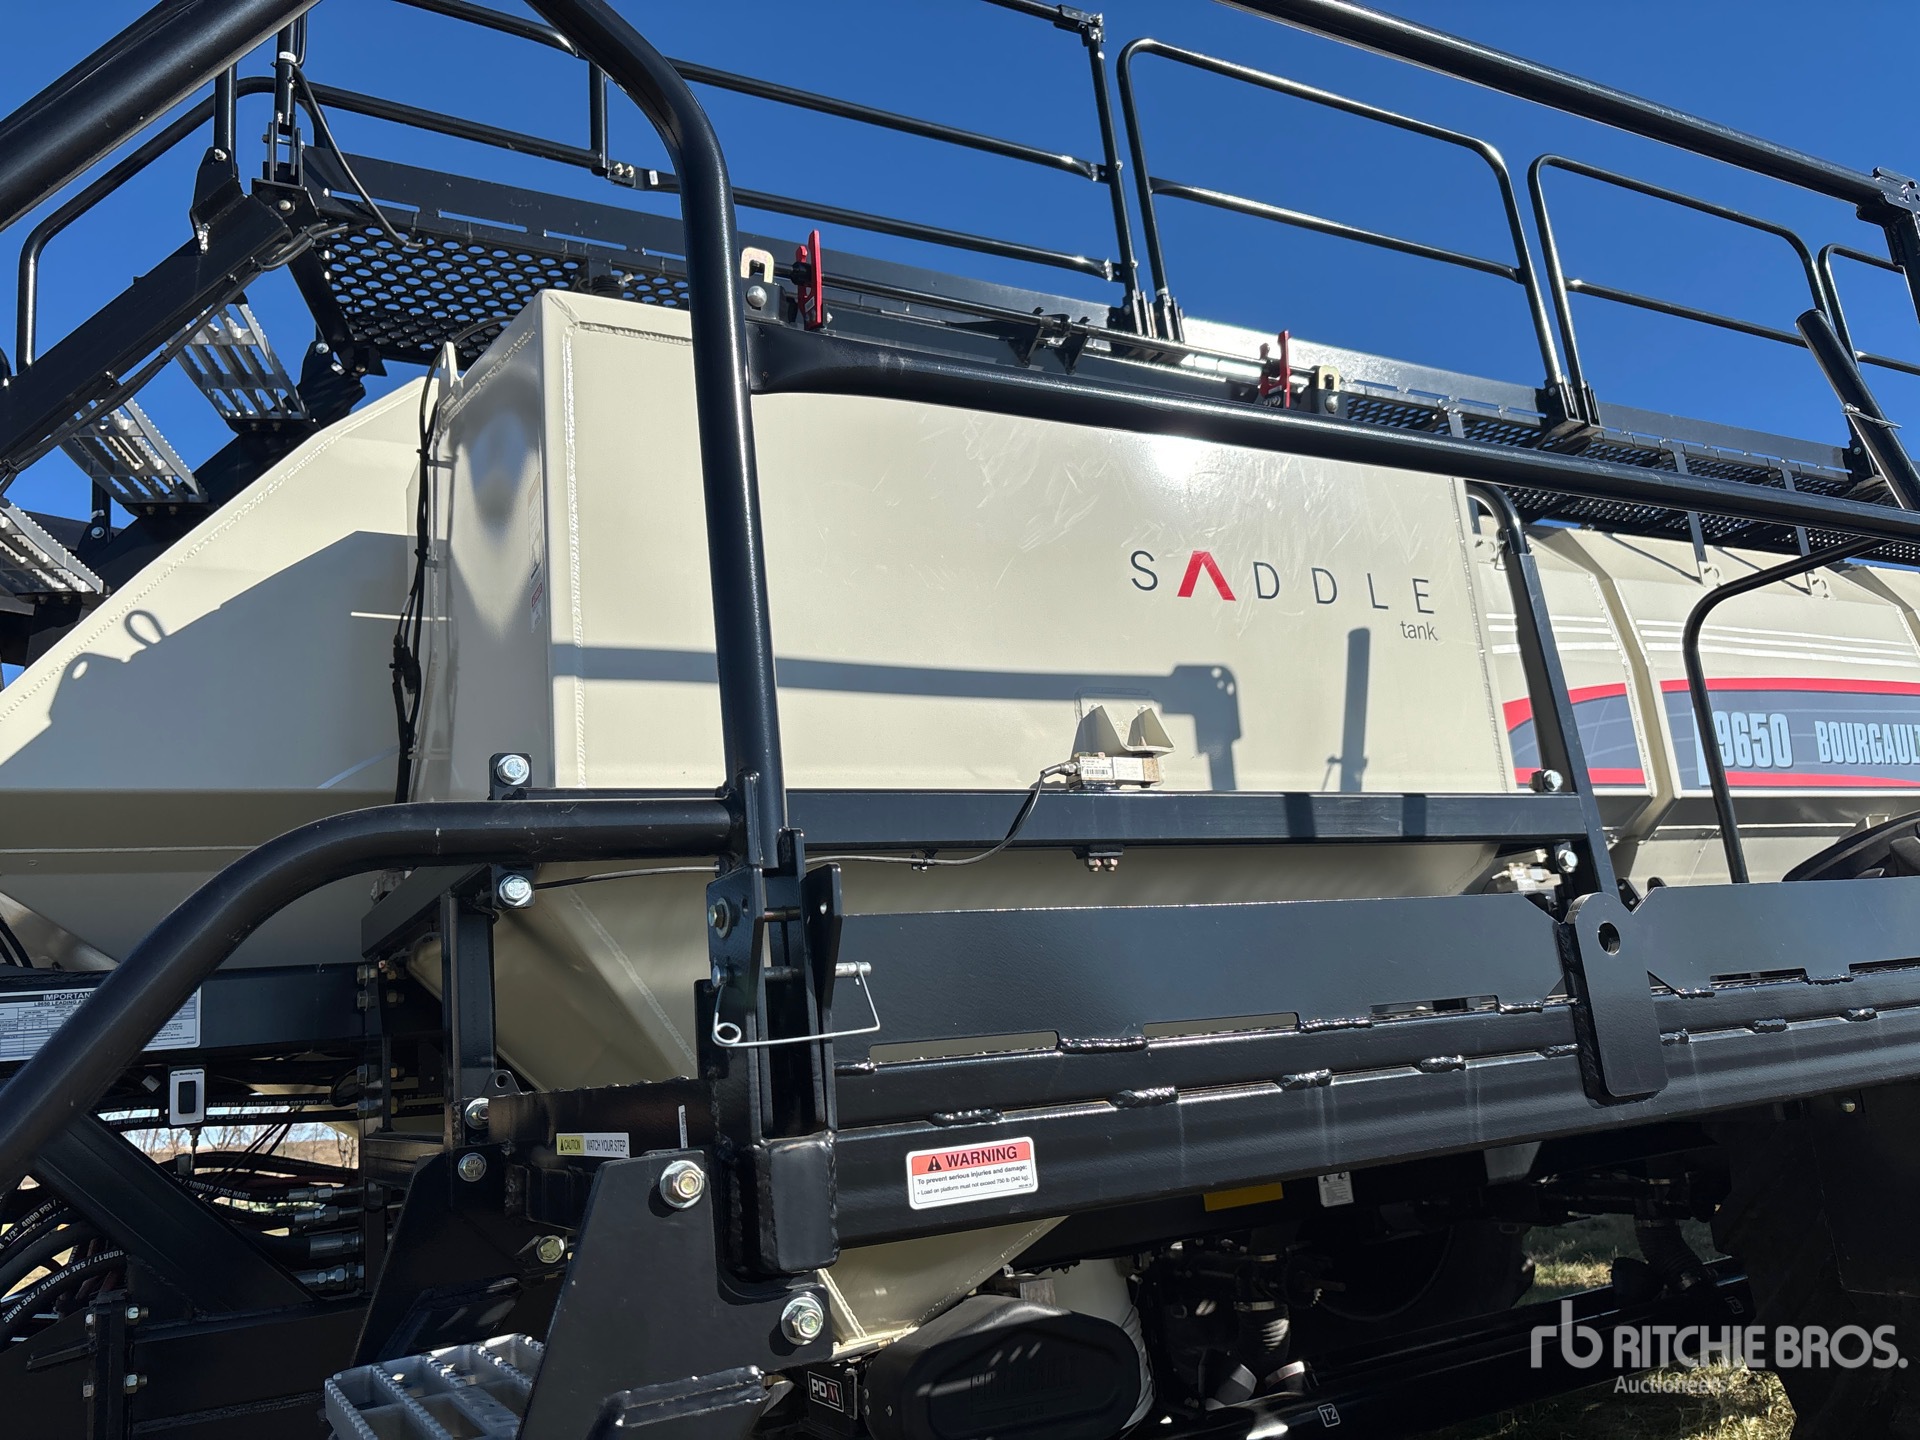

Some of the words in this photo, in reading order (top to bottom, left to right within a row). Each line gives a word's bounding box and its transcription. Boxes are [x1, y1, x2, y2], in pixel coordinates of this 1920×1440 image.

[1400, 620, 1438, 641] tank
[43, 992, 91, 1001] IMPORTAN
[564, 1139, 581, 1150] CAUTION
[586, 1139, 600, 1151] WATCH
[601, 1139, 614, 1152] YOUR
[614, 1139, 626, 1152] STEP
[946, 1146, 1017, 1167] WARNING
[926, 1175, 948, 1185] prevent
[948, 1172, 970, 1181] serious
[970, 1169, 992, 1179] injuries
[992, 1167, 1004, 1175] and
[921, 1188, 933, 1196] Load
[940, 1184, 959, 1194] platform
[959, 1182, 971, 1190] must
[979, 1178, 996, 1187] exceed
[21, 1211, 41, 1228] 4000
[38, 1202, 53, 1215] PSI
[70, 1260, 86, 1273] SAE
[22, 1291, 36, 1306] 2SC
[1321, 1407, 1338, 1421] T2
